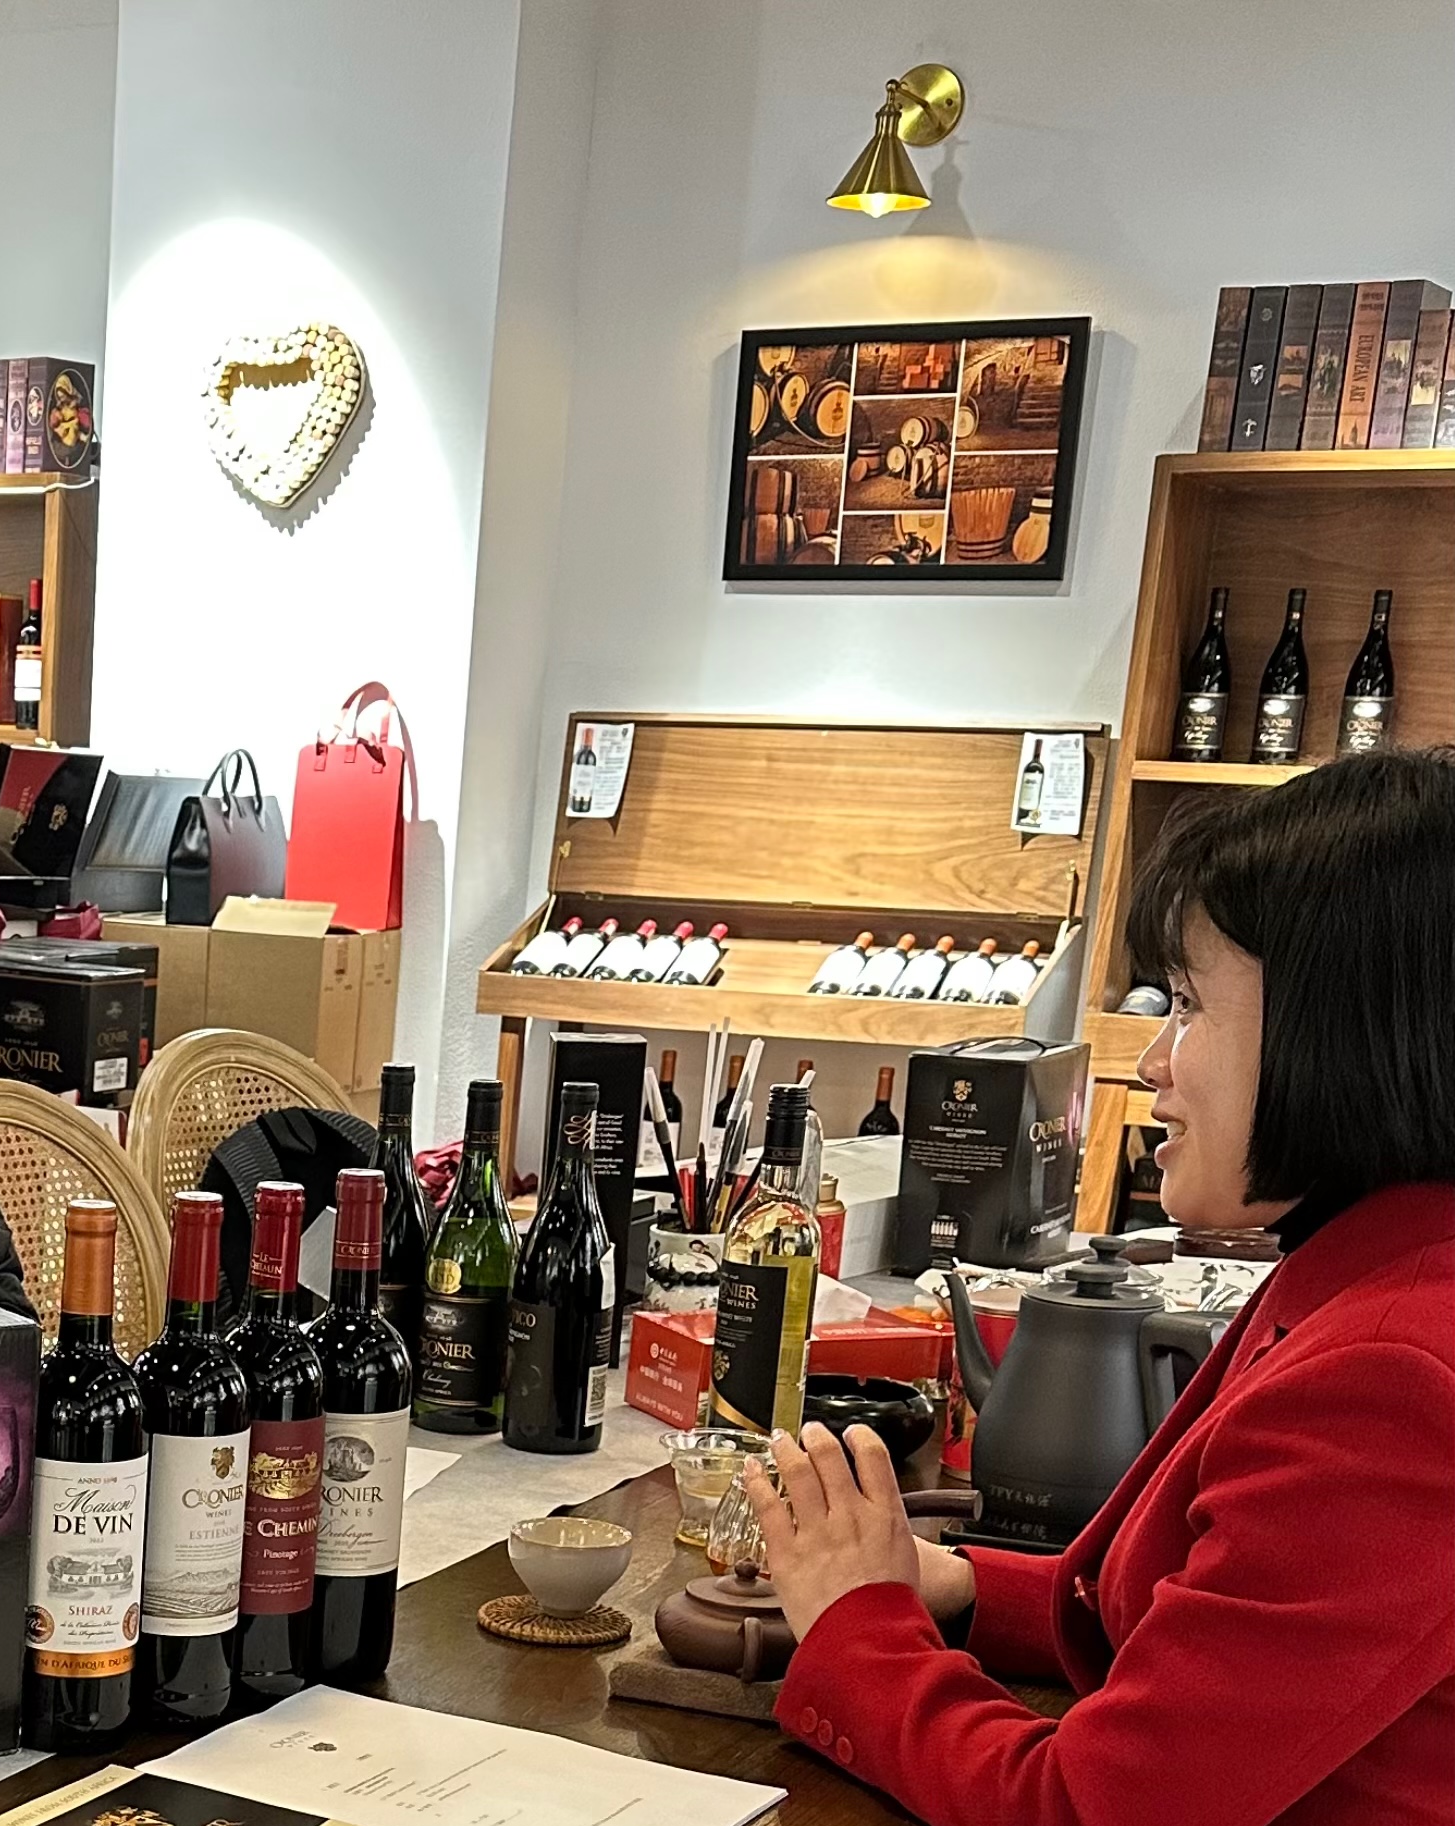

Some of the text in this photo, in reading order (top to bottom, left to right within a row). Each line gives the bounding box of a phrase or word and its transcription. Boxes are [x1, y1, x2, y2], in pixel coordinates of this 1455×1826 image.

[1352, 334, 1375, 383] EUROPEAN
[1349, 384, 1366, 403] ART
[53, 1485, 137, 1514] Maison
[321, 1487, 384, 1507] RONIER
[321, 1507, 373, 1517] INES
[53, 1513, 133, 1535] DE VIN
[257, 1515, 318, 1538] CHEMIN
[68, 1605, 113, 1616] SHIRAZ
